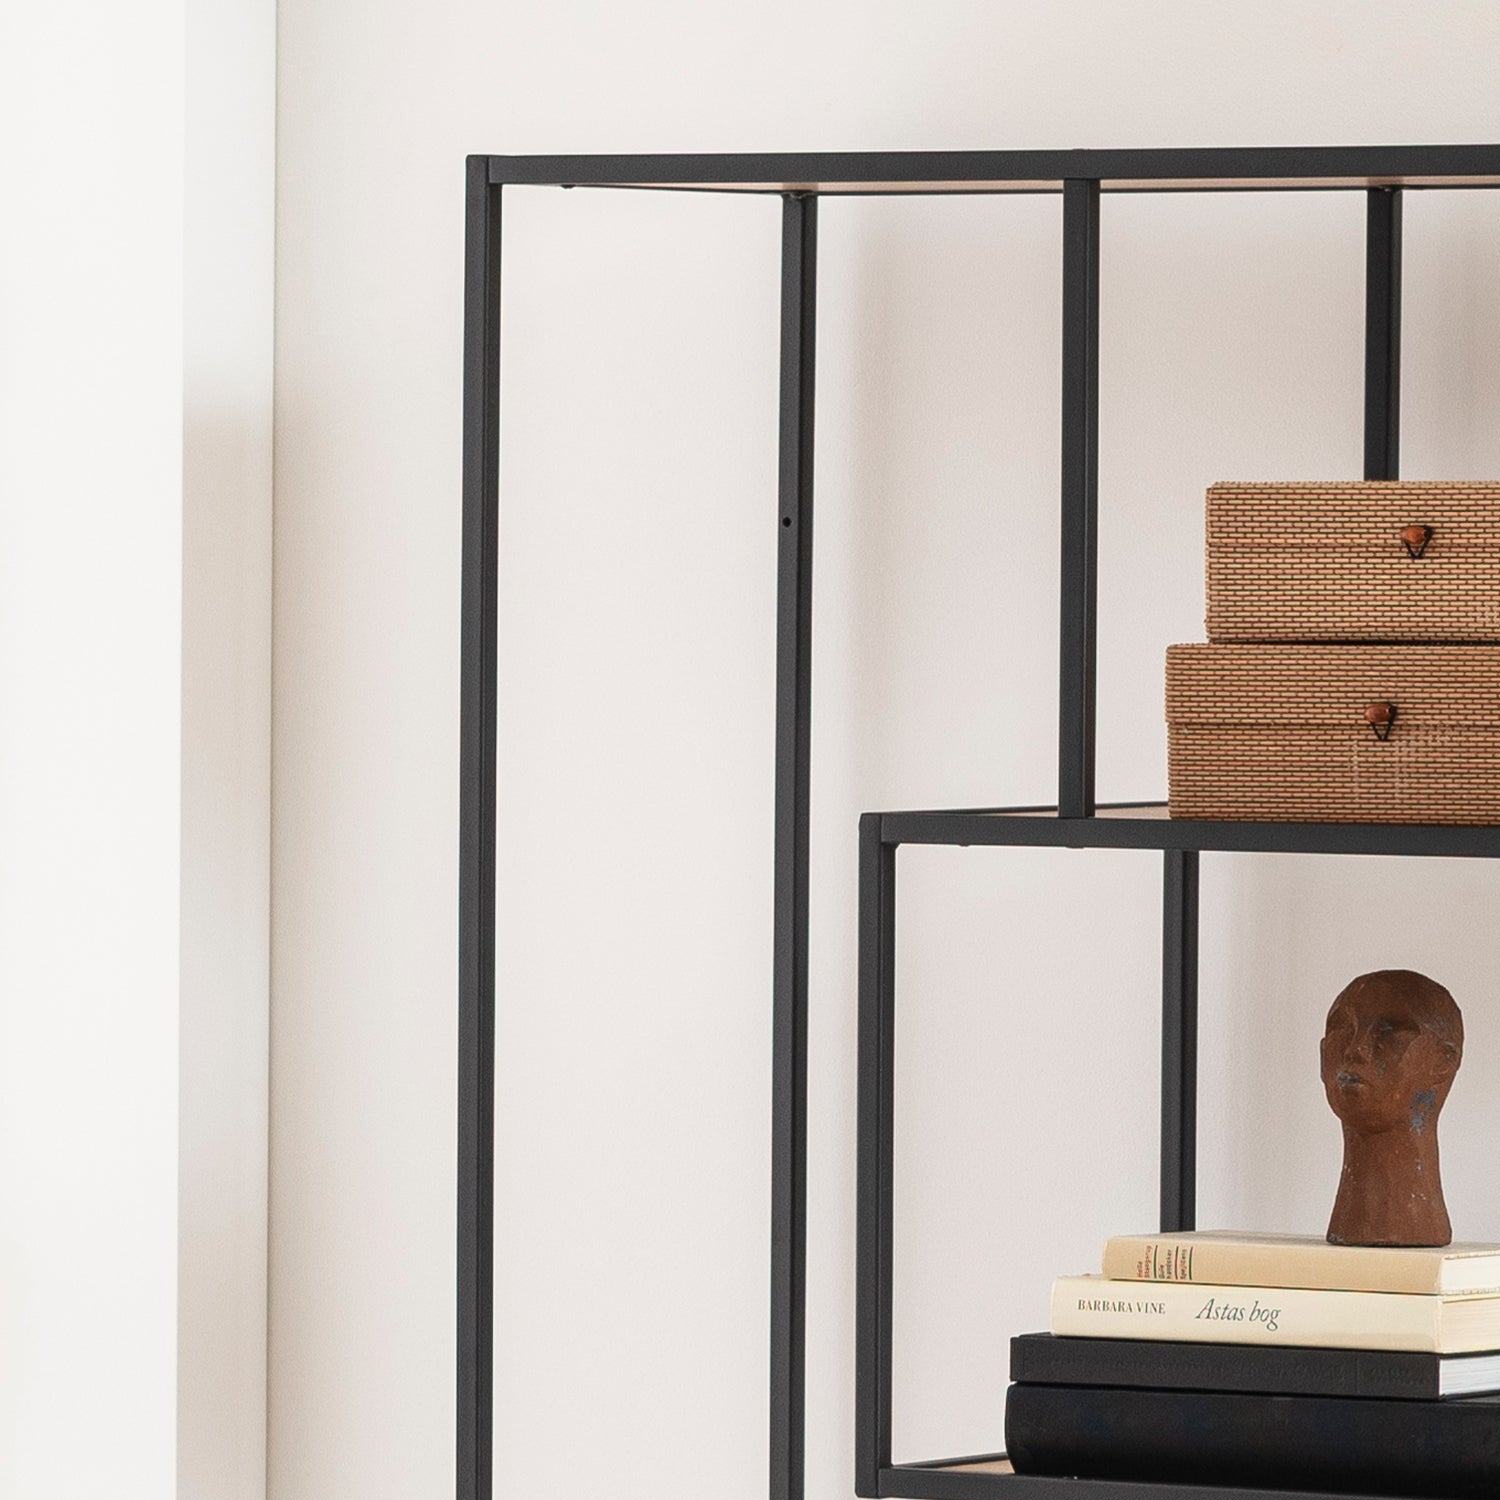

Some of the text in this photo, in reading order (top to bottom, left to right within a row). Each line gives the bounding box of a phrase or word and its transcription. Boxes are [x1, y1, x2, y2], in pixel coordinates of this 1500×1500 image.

[1077, 1297, 1282, 1332] BARBARA VINE Astas bog
